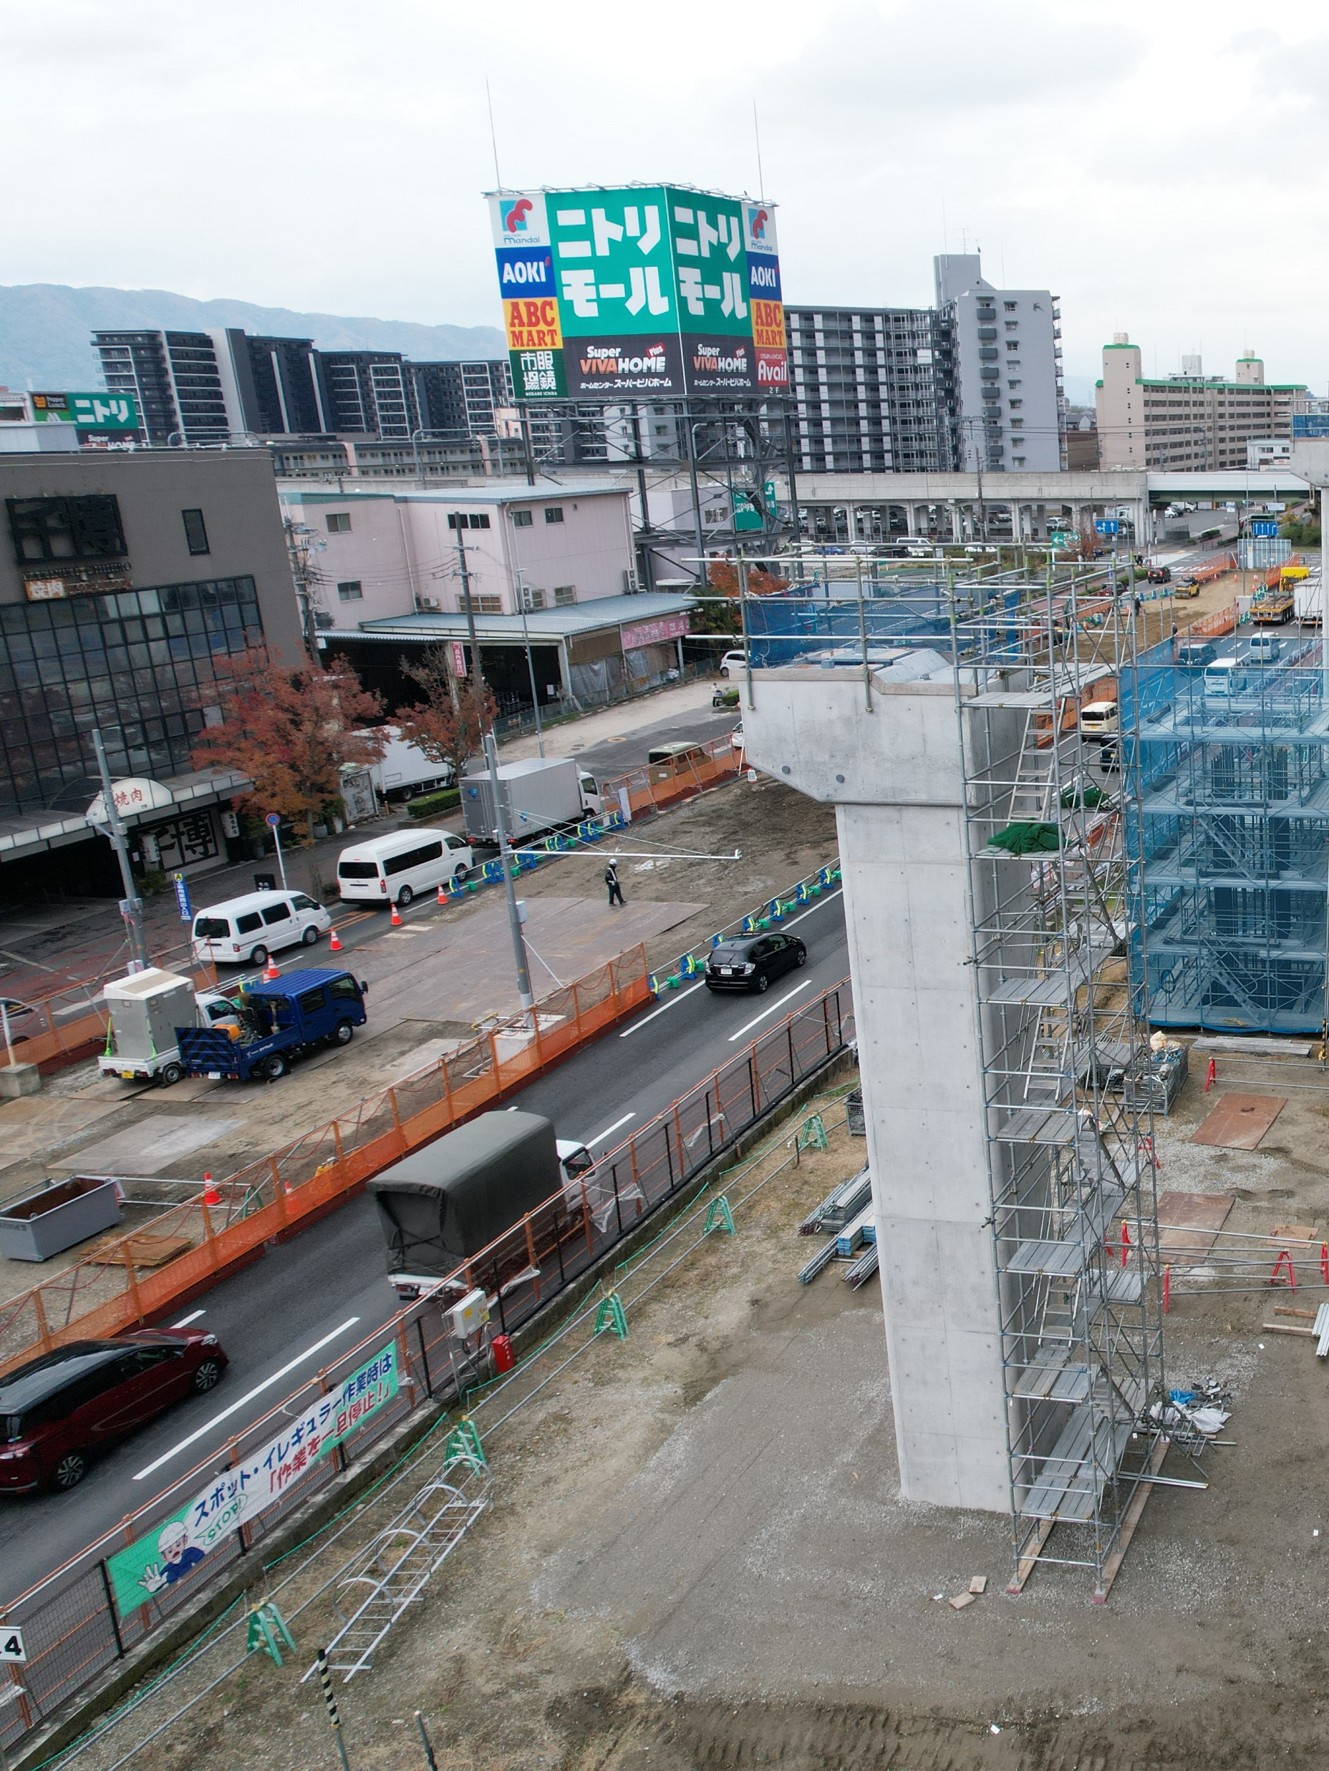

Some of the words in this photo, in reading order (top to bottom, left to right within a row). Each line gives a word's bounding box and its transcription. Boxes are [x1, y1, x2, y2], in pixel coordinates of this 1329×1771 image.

[556, 205, 661, 258] ニトリ
[674, 206, 741, 263] ニトリ
[502, 261, 546, 284] AOKI
[751, 265, 777, 288] AOKI
[560, 266, 670, 318] モール
[678, 266, 748, 320] モール
[509, 300, 555, 328] ABC
[755, 301, 782, 328] ABC
[511, 329, 558, 347] MART
[755, 328, 783, 346] MART
[587, 345, 622, 360] Super
[697, 343, 720, 358] Super
[580, 356, 666, 375] VIVAHOME
[693, 356, 747, 373] VIVAHOME
[757, 360, 787, 381] Avail
[75, 400, 129, 423] ニトリ
[114, 788, 142, 807] 焼肉
